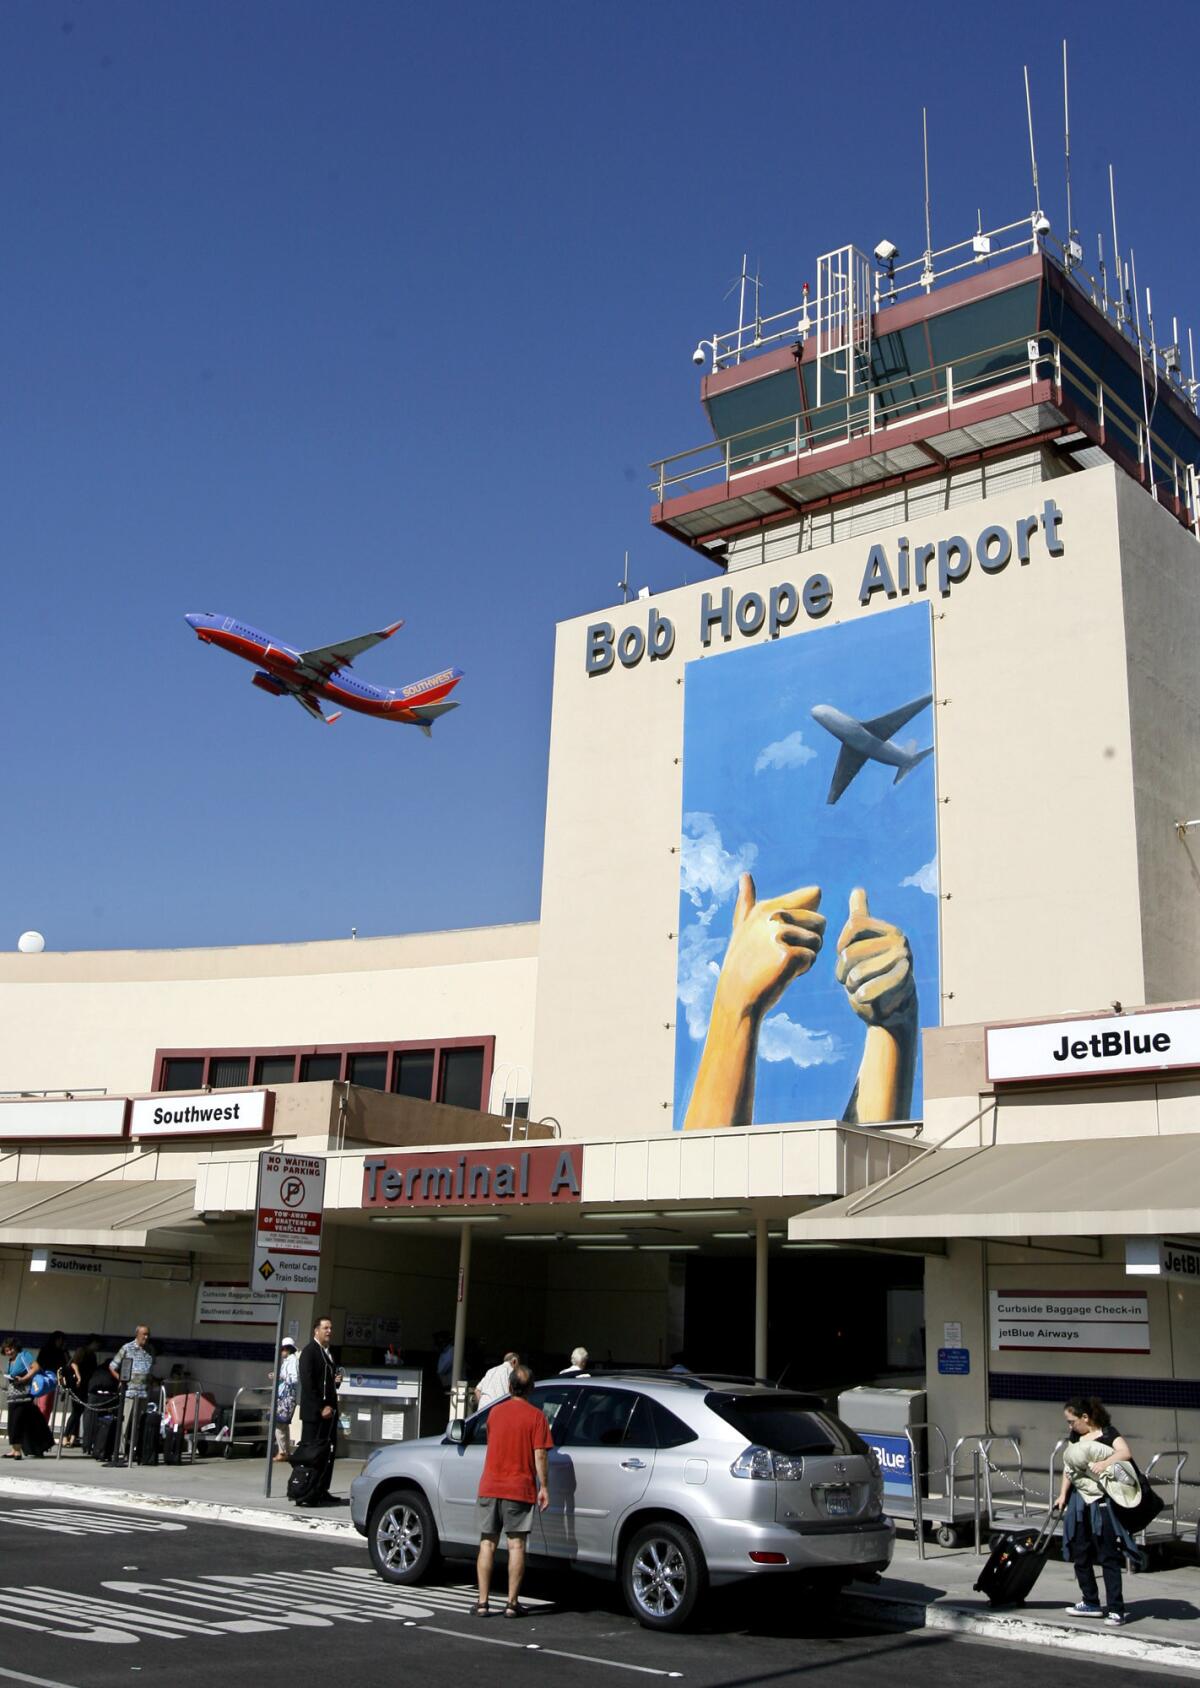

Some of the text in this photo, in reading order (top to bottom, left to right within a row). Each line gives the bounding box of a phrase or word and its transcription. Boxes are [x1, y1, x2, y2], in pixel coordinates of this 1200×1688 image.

[585, 499, 1065, 678] Bob Hope Airport
[402, 671, 454, 698] SOUTHWEST
[1053, 1030, 1171, 1061] JetBlue
[153, 1103, 240, 1125] Southwest
[269, 1156, 320, 1168] NO WAITING
[266, 1164, 320, 1176] NO PARKING
[363, 1150, 580, 1202] Terminal A
[275, 1218, 316, 1227] UNATTENDED
[274, 1225, 306, 1233] VEHICLES
[50, 1257, 102, 1272] Southwest
[279, 1261, 317, 1271] Rental Cars
[275, 1273, 317, 1283] Train Station
[997, 1304, 1142, 1315] Curbside Baggage Check-in
[999, 1328, 1080, 1340] jetBlue Airways
